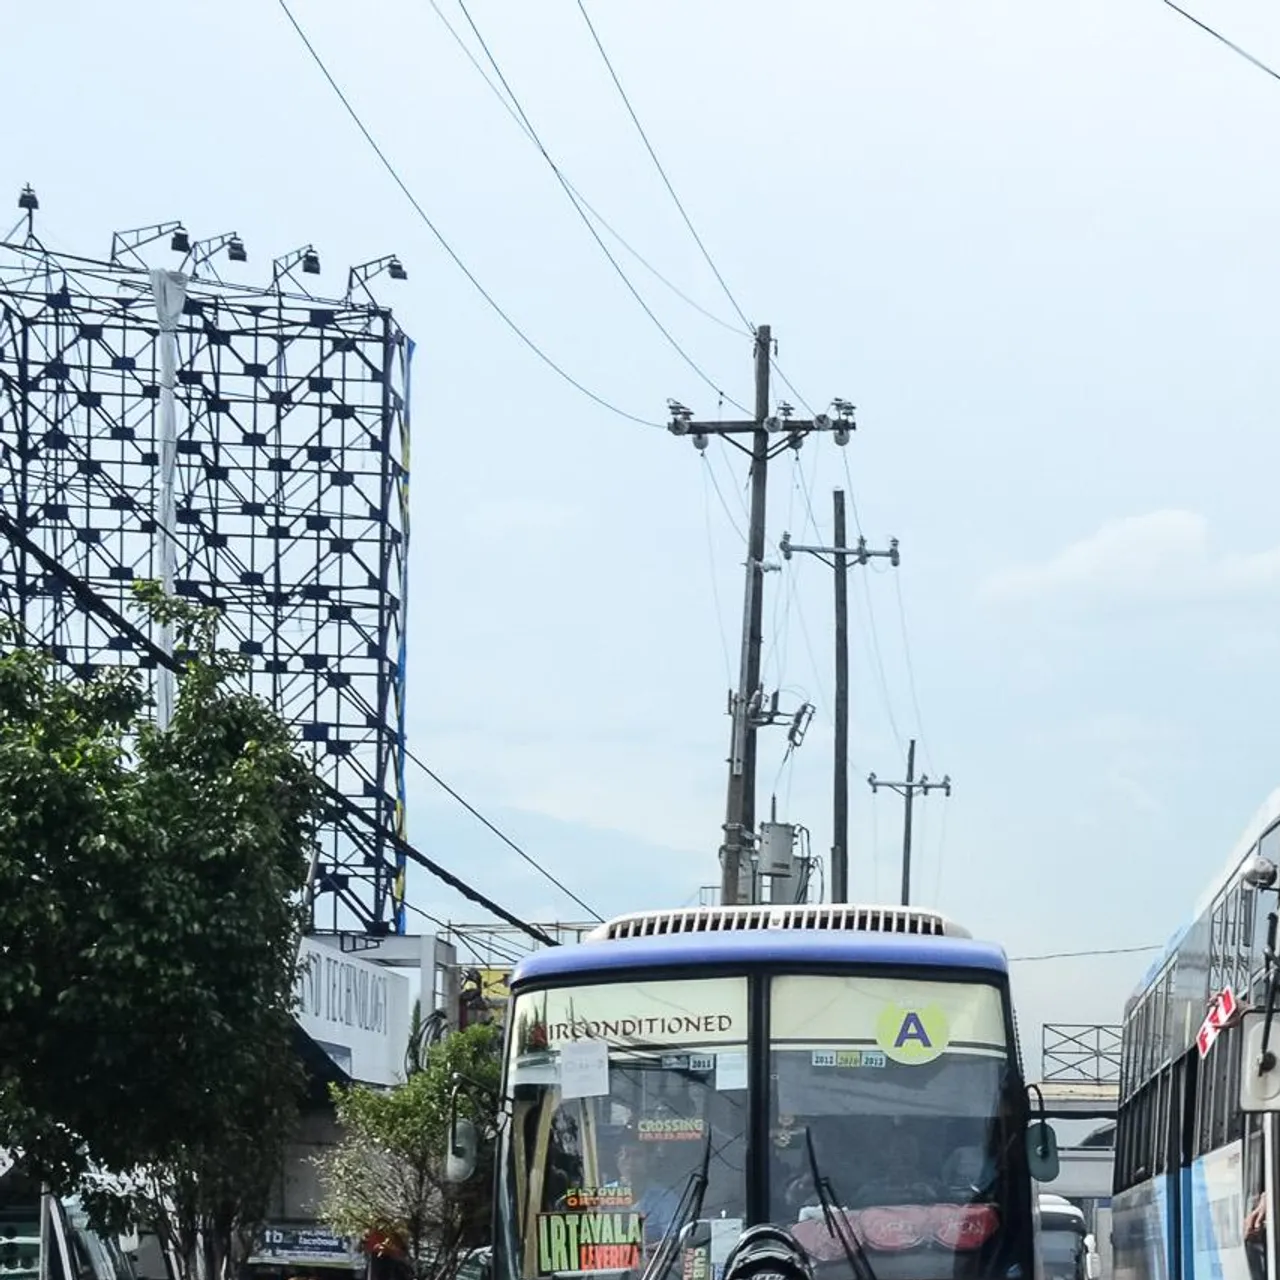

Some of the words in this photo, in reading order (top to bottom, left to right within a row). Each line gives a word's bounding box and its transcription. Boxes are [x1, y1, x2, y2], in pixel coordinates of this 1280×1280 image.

[893, 1012, 932, 1048] A
[637, 1119, 704, 1132] CROSSING
[539, 1214, 579, 1272] LRT
[580, 1213, 642, 1244] AYALA
[581, 1245, 641, 1271] LEVERIZA
